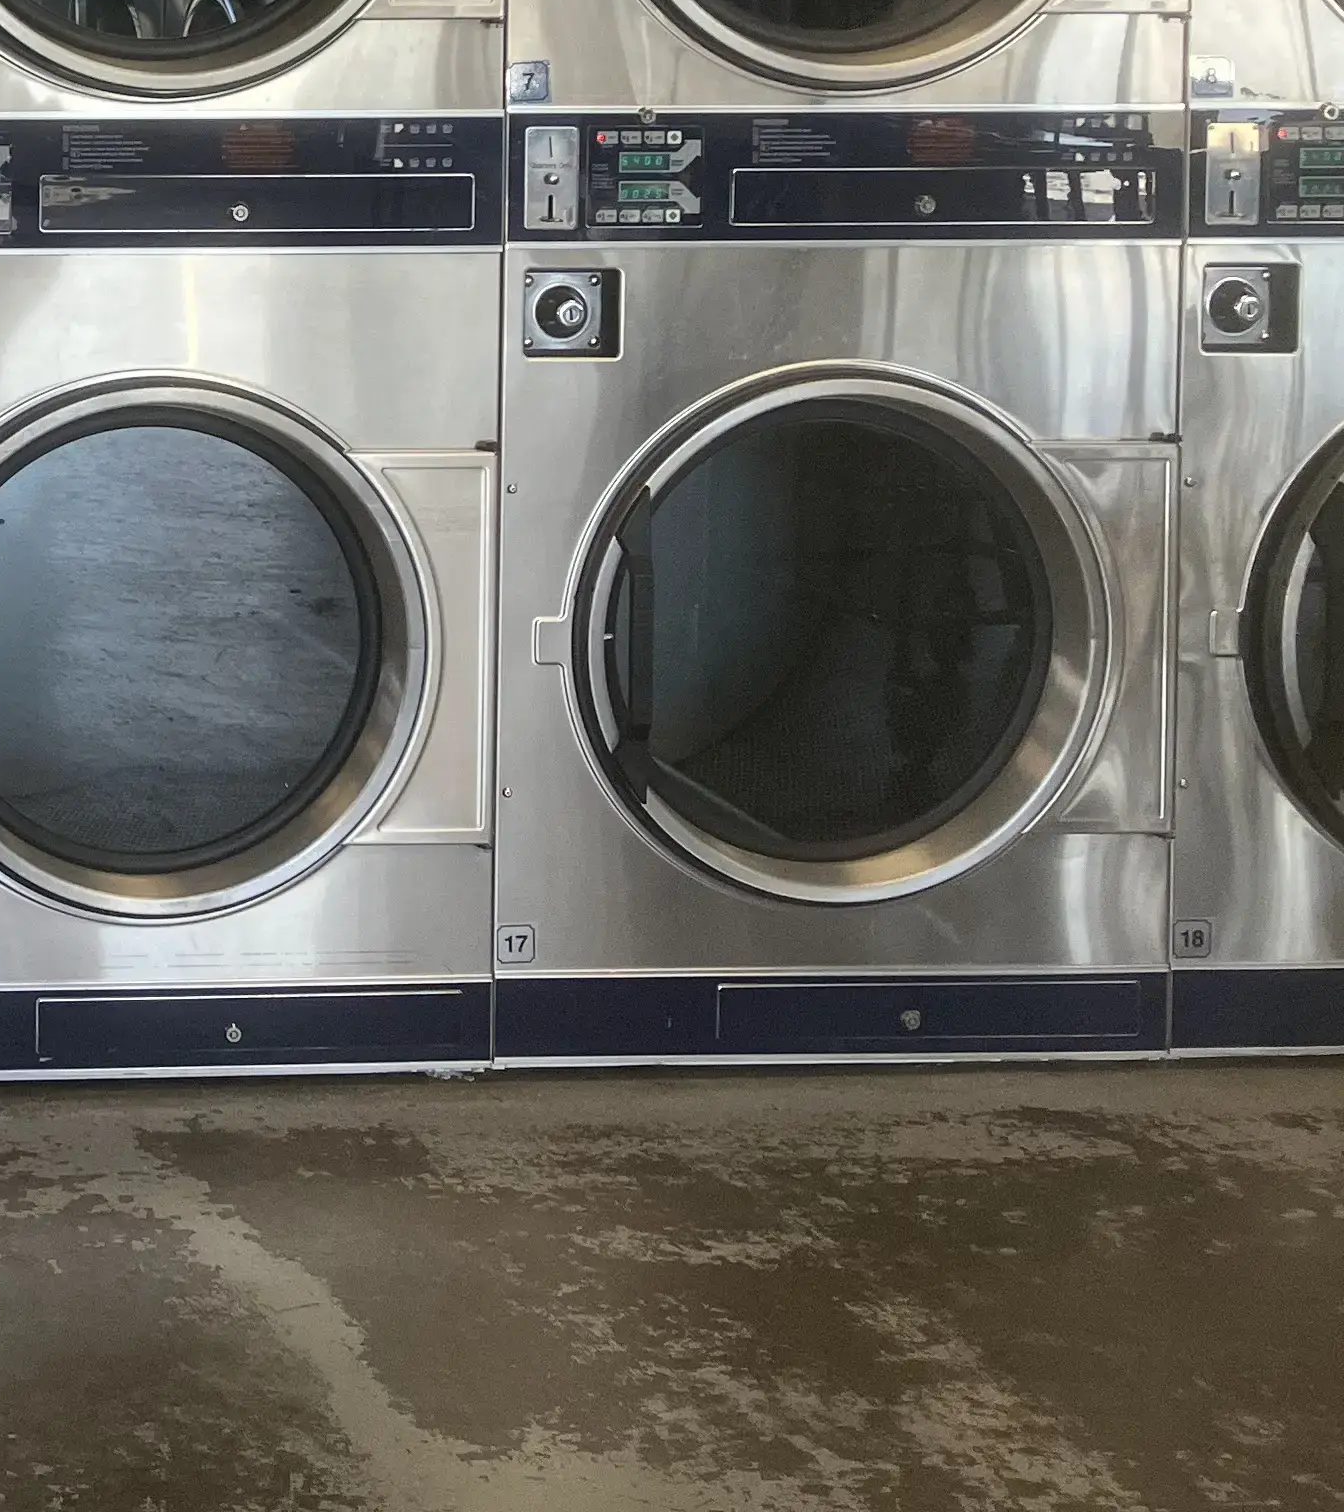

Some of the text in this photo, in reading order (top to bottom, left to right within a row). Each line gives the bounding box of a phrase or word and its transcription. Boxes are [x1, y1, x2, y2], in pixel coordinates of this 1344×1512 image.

[522, 73, 535, 90] 7
[504, 934, 529, 954] 17
[1180, 930, 1204, 948] 18
